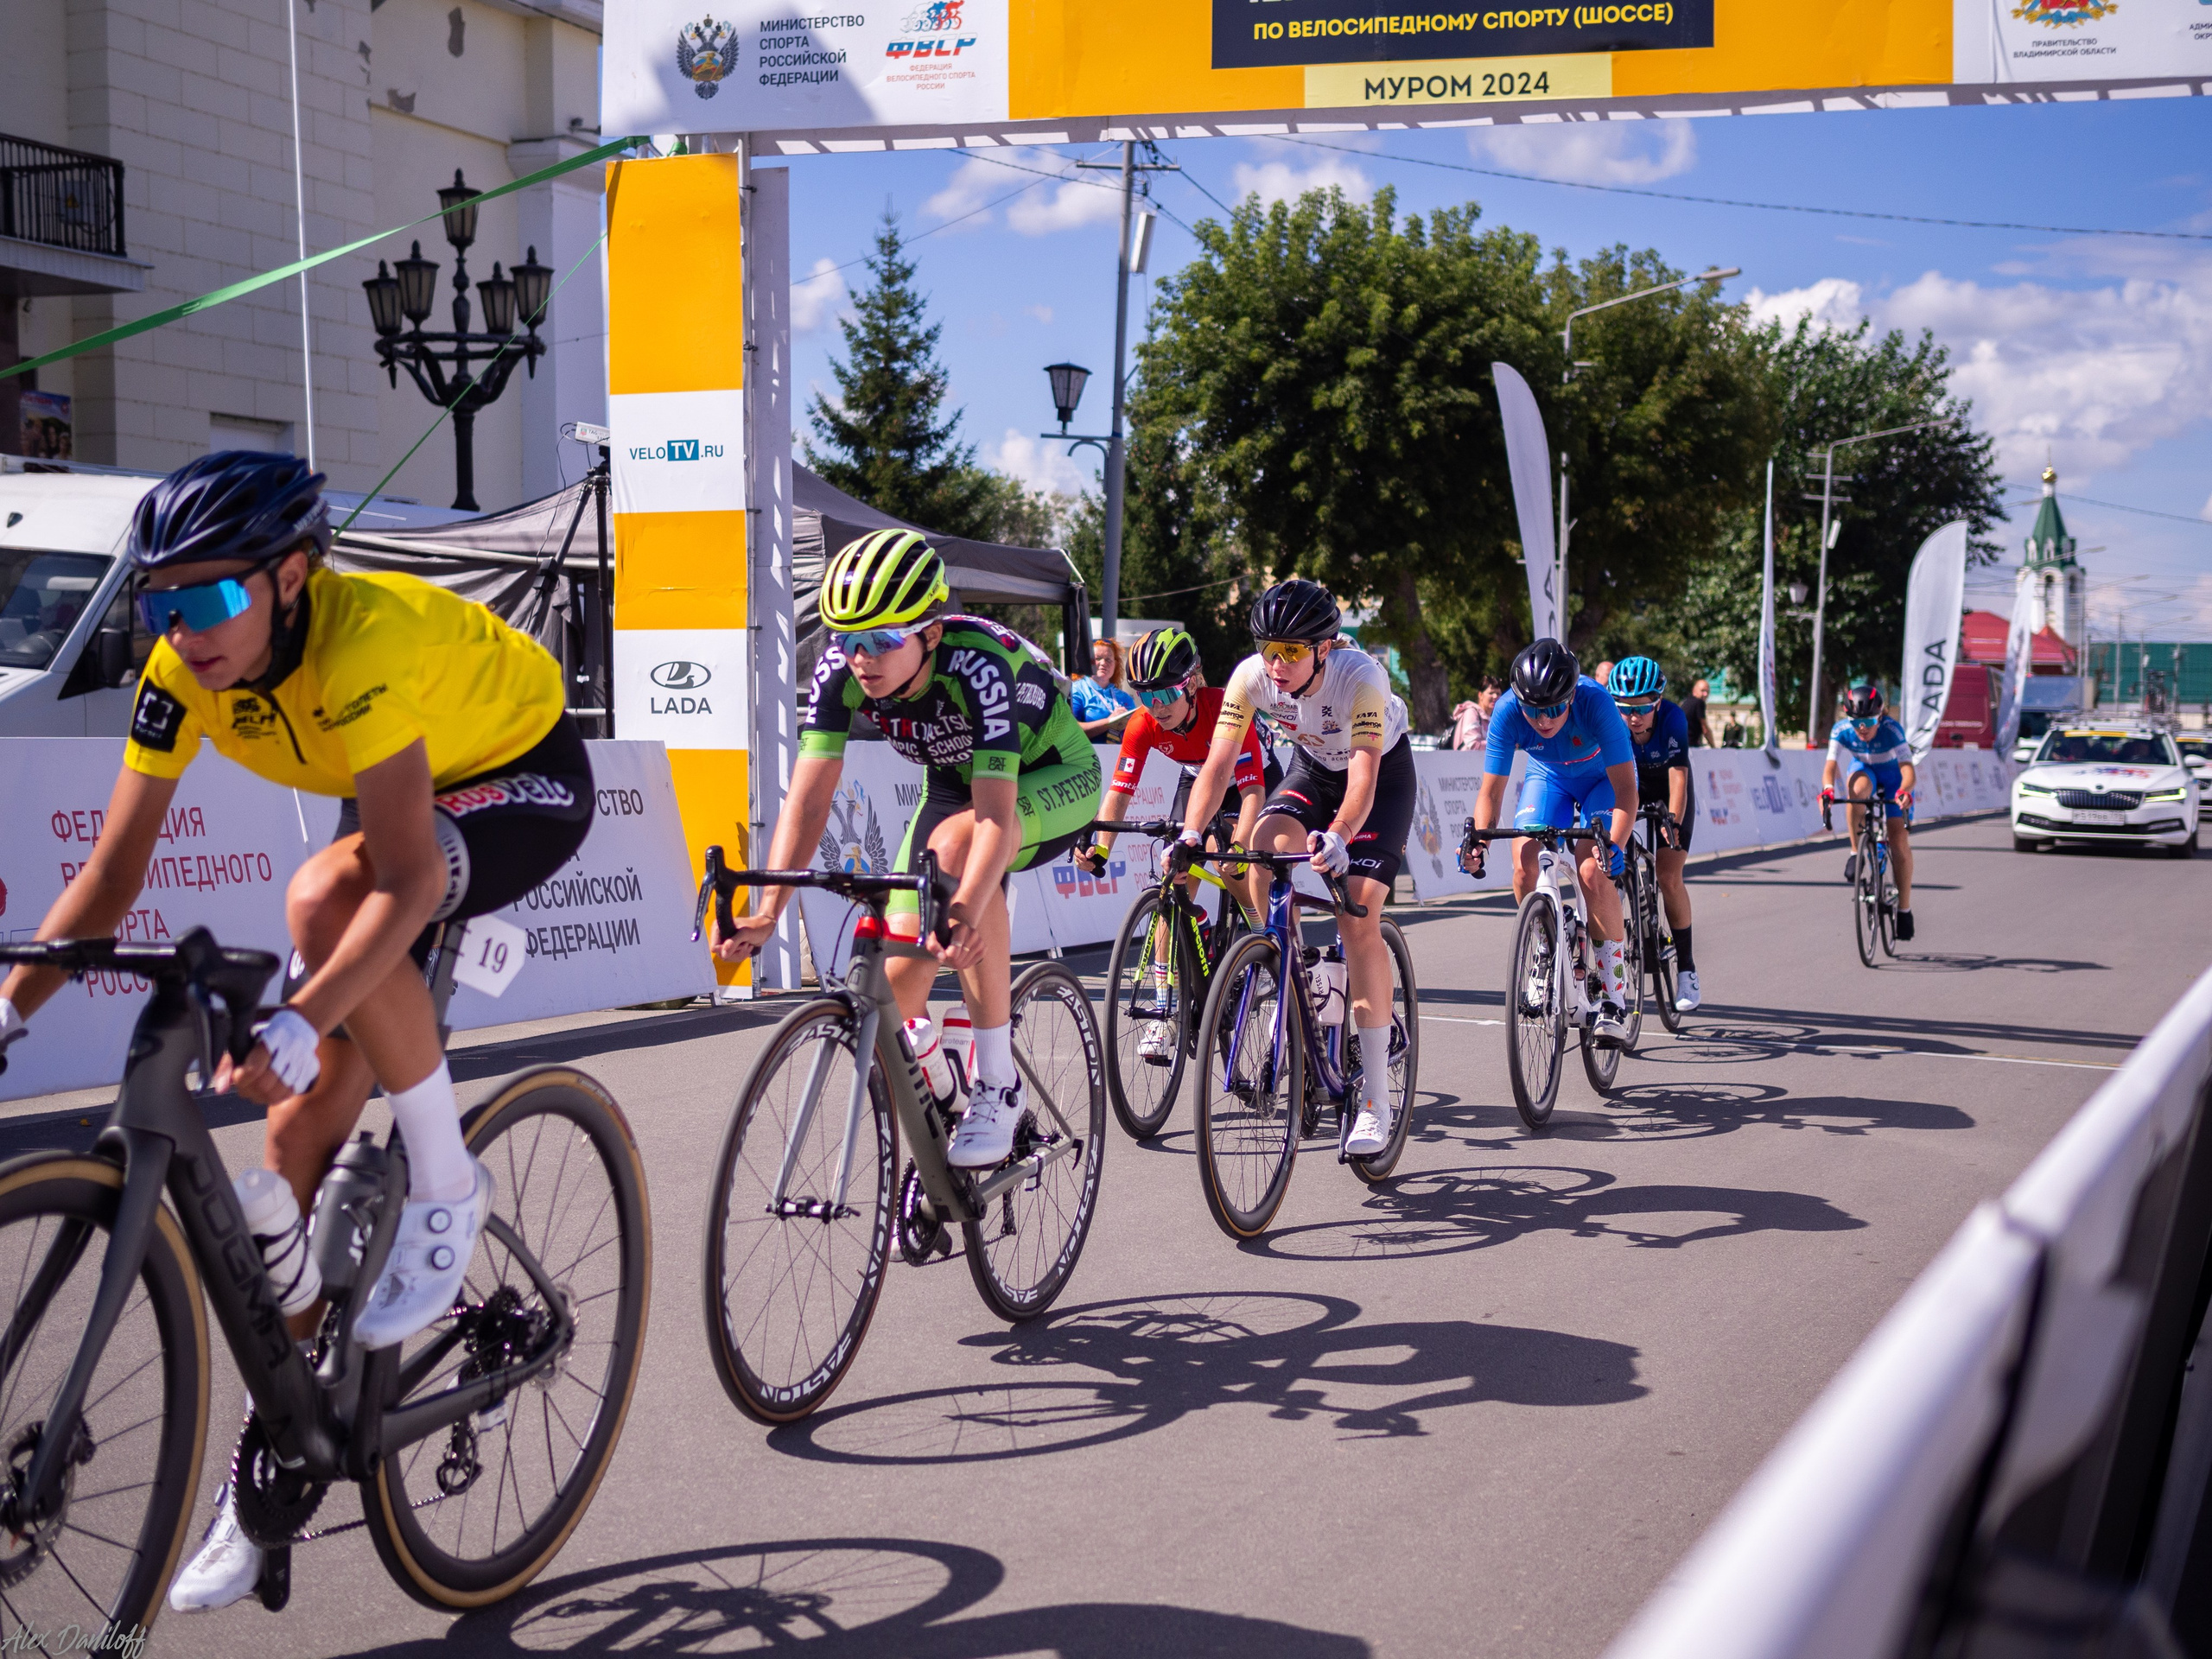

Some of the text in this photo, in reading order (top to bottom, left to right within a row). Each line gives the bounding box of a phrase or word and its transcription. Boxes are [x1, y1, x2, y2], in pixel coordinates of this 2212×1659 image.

[760, 15, 864, 32] МИНИСТЕРСТВО
[1254, 2, 1674, 40] ПО ВЕЛОСИПЕДНОМУ СПОРТУ (ШОССЕ)
[760, 36, 809, 50] СПОРТА
[886, 33, 978, 59] ФВСР
[2013, 48, 2116, 58] ВЛАДИМИРСКОЙ ОБЛАСТИ
[2032, 38, 2097, 48] ПРАВИТЕЛЬСТВО
[760, 49, 846, 67] РОССИЙСКОЙ
[910, 63, 952, 72] ФЕДЕРАЦИЯ
[760, 70, 838, 86] ФЕДЕРАЦИИ
[887, 73, 947, 82] ВЕЛОСИПЕДНОГО
[1364, 71, 1550, 100] МУРОМ 2024
[651, 697, 712, 715] LADA
[948, 650, 1011, 741] RUSSIA
[927, 735, 974, 757] SCHOO
[988, 756, 1007, 765] FAT
[1237, 773, 1258, 785] antic
[51, 806, 206, 844] ФЕДЦИЯ
[479, 937, 509, 974] 19
[1056, 986, 1101, 1086] EASTON
[867, 1112, 893, 1289] EASTON
[1058, 1133, 1099, 1276] EASTON
[187, 1154, 293, 1370] DOGMA
[760, 1332, 852, 1403] EASTON
